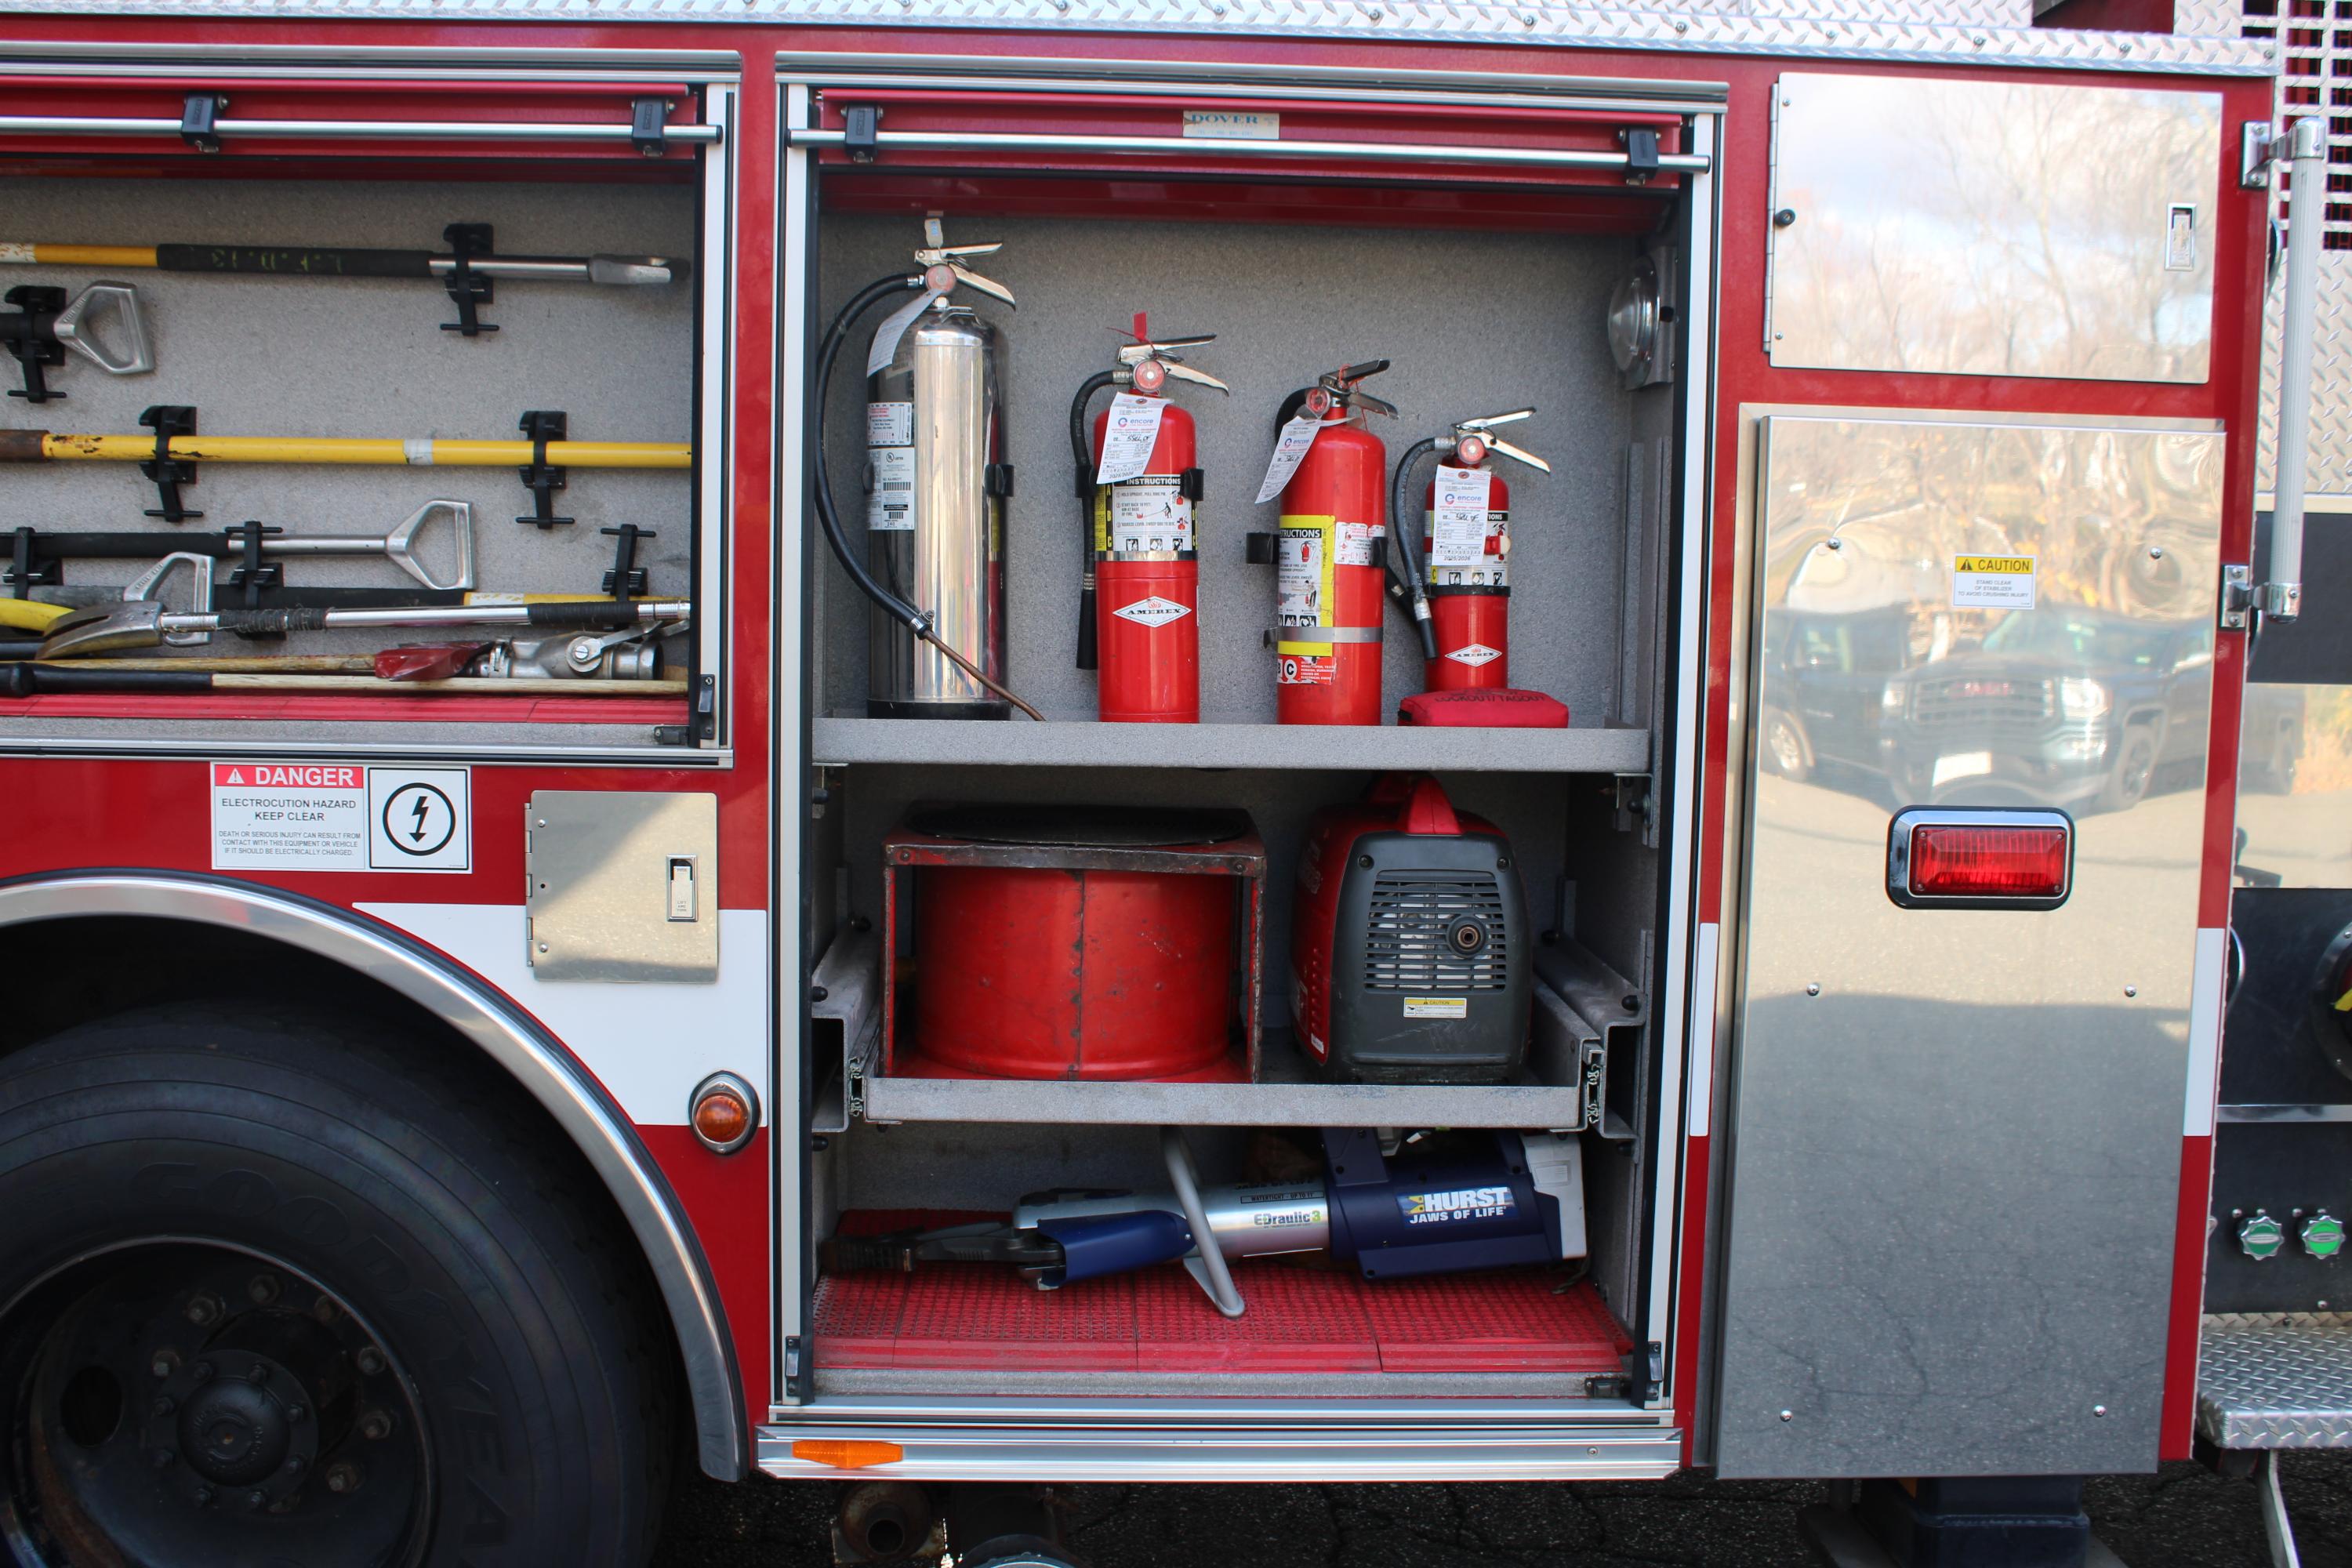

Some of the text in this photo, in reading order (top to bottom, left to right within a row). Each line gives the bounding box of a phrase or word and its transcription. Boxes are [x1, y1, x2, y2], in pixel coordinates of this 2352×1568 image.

[1279, 529, 1320, 538] STRUCTIONS
[1107, 536, 1112, 548] C
[1978, 559, 2030, 572] CAUTION
[1432, 569, 1436, 580] C
[1287, 663, 1294, 675] C
[255, 766, 354, 786] DANGER
[222, 798, 357, 808] ELECTROCUTION HAZARD
[255, 811, 325, 821] KEEP CLEAR
[1424, 1187, 1508, 1212] HURST
[1410, 1211, 1449, 1224] JAWS
[1454, 1210, 1471, 1220] OF
[131, 1162, 511, 1568] GOODYEA
